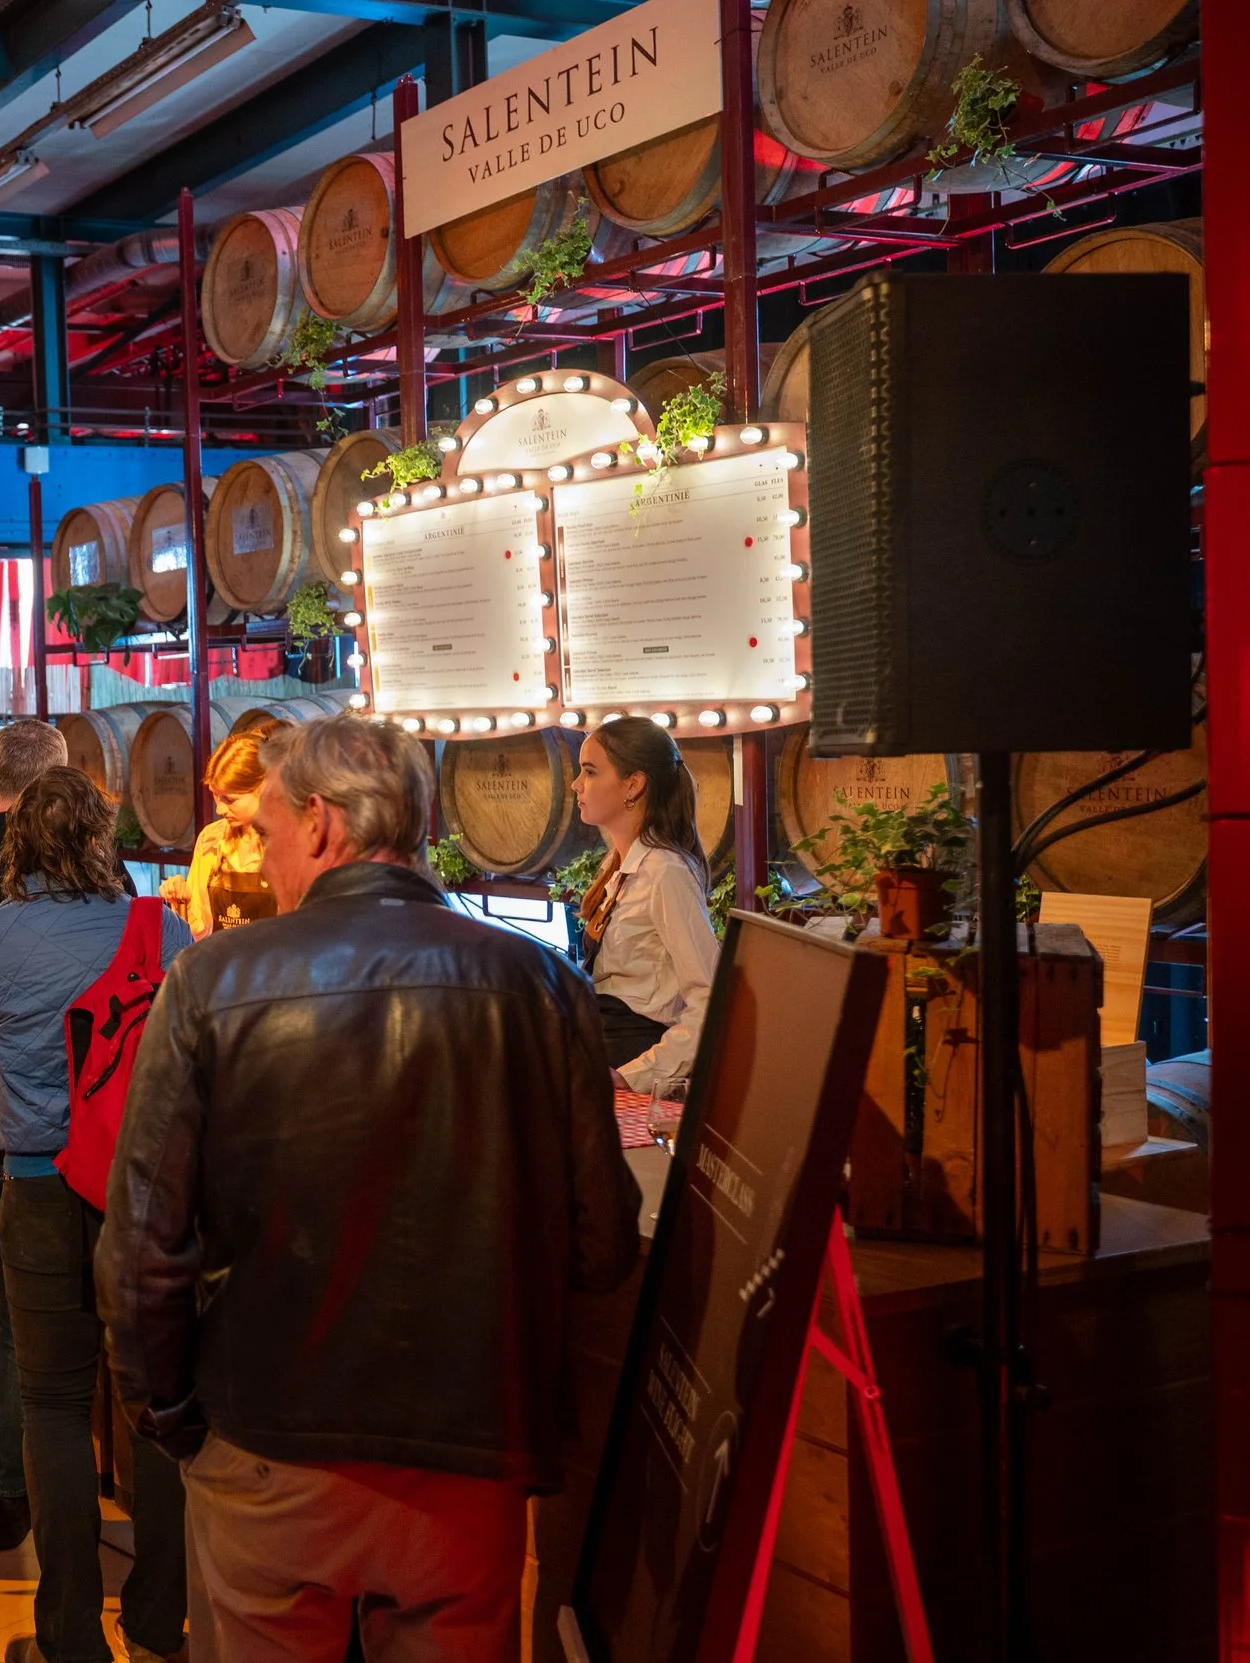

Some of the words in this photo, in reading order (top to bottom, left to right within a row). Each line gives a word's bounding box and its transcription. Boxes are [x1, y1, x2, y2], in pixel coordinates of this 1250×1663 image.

[810, 25, 888, 68] SALENTEIN
[442, 26, 659, 162] SALENTEIN
[468, 142, 531, 184] VALLE
[539, 126, 567, 155] DE
[576, 102, 626, 138] UCO
[518, 428, 567, 447] SALENTEIN
[476, 780, 528, 790] SALENTEIN
[219, 915, 250, 925] SALENTEIN
